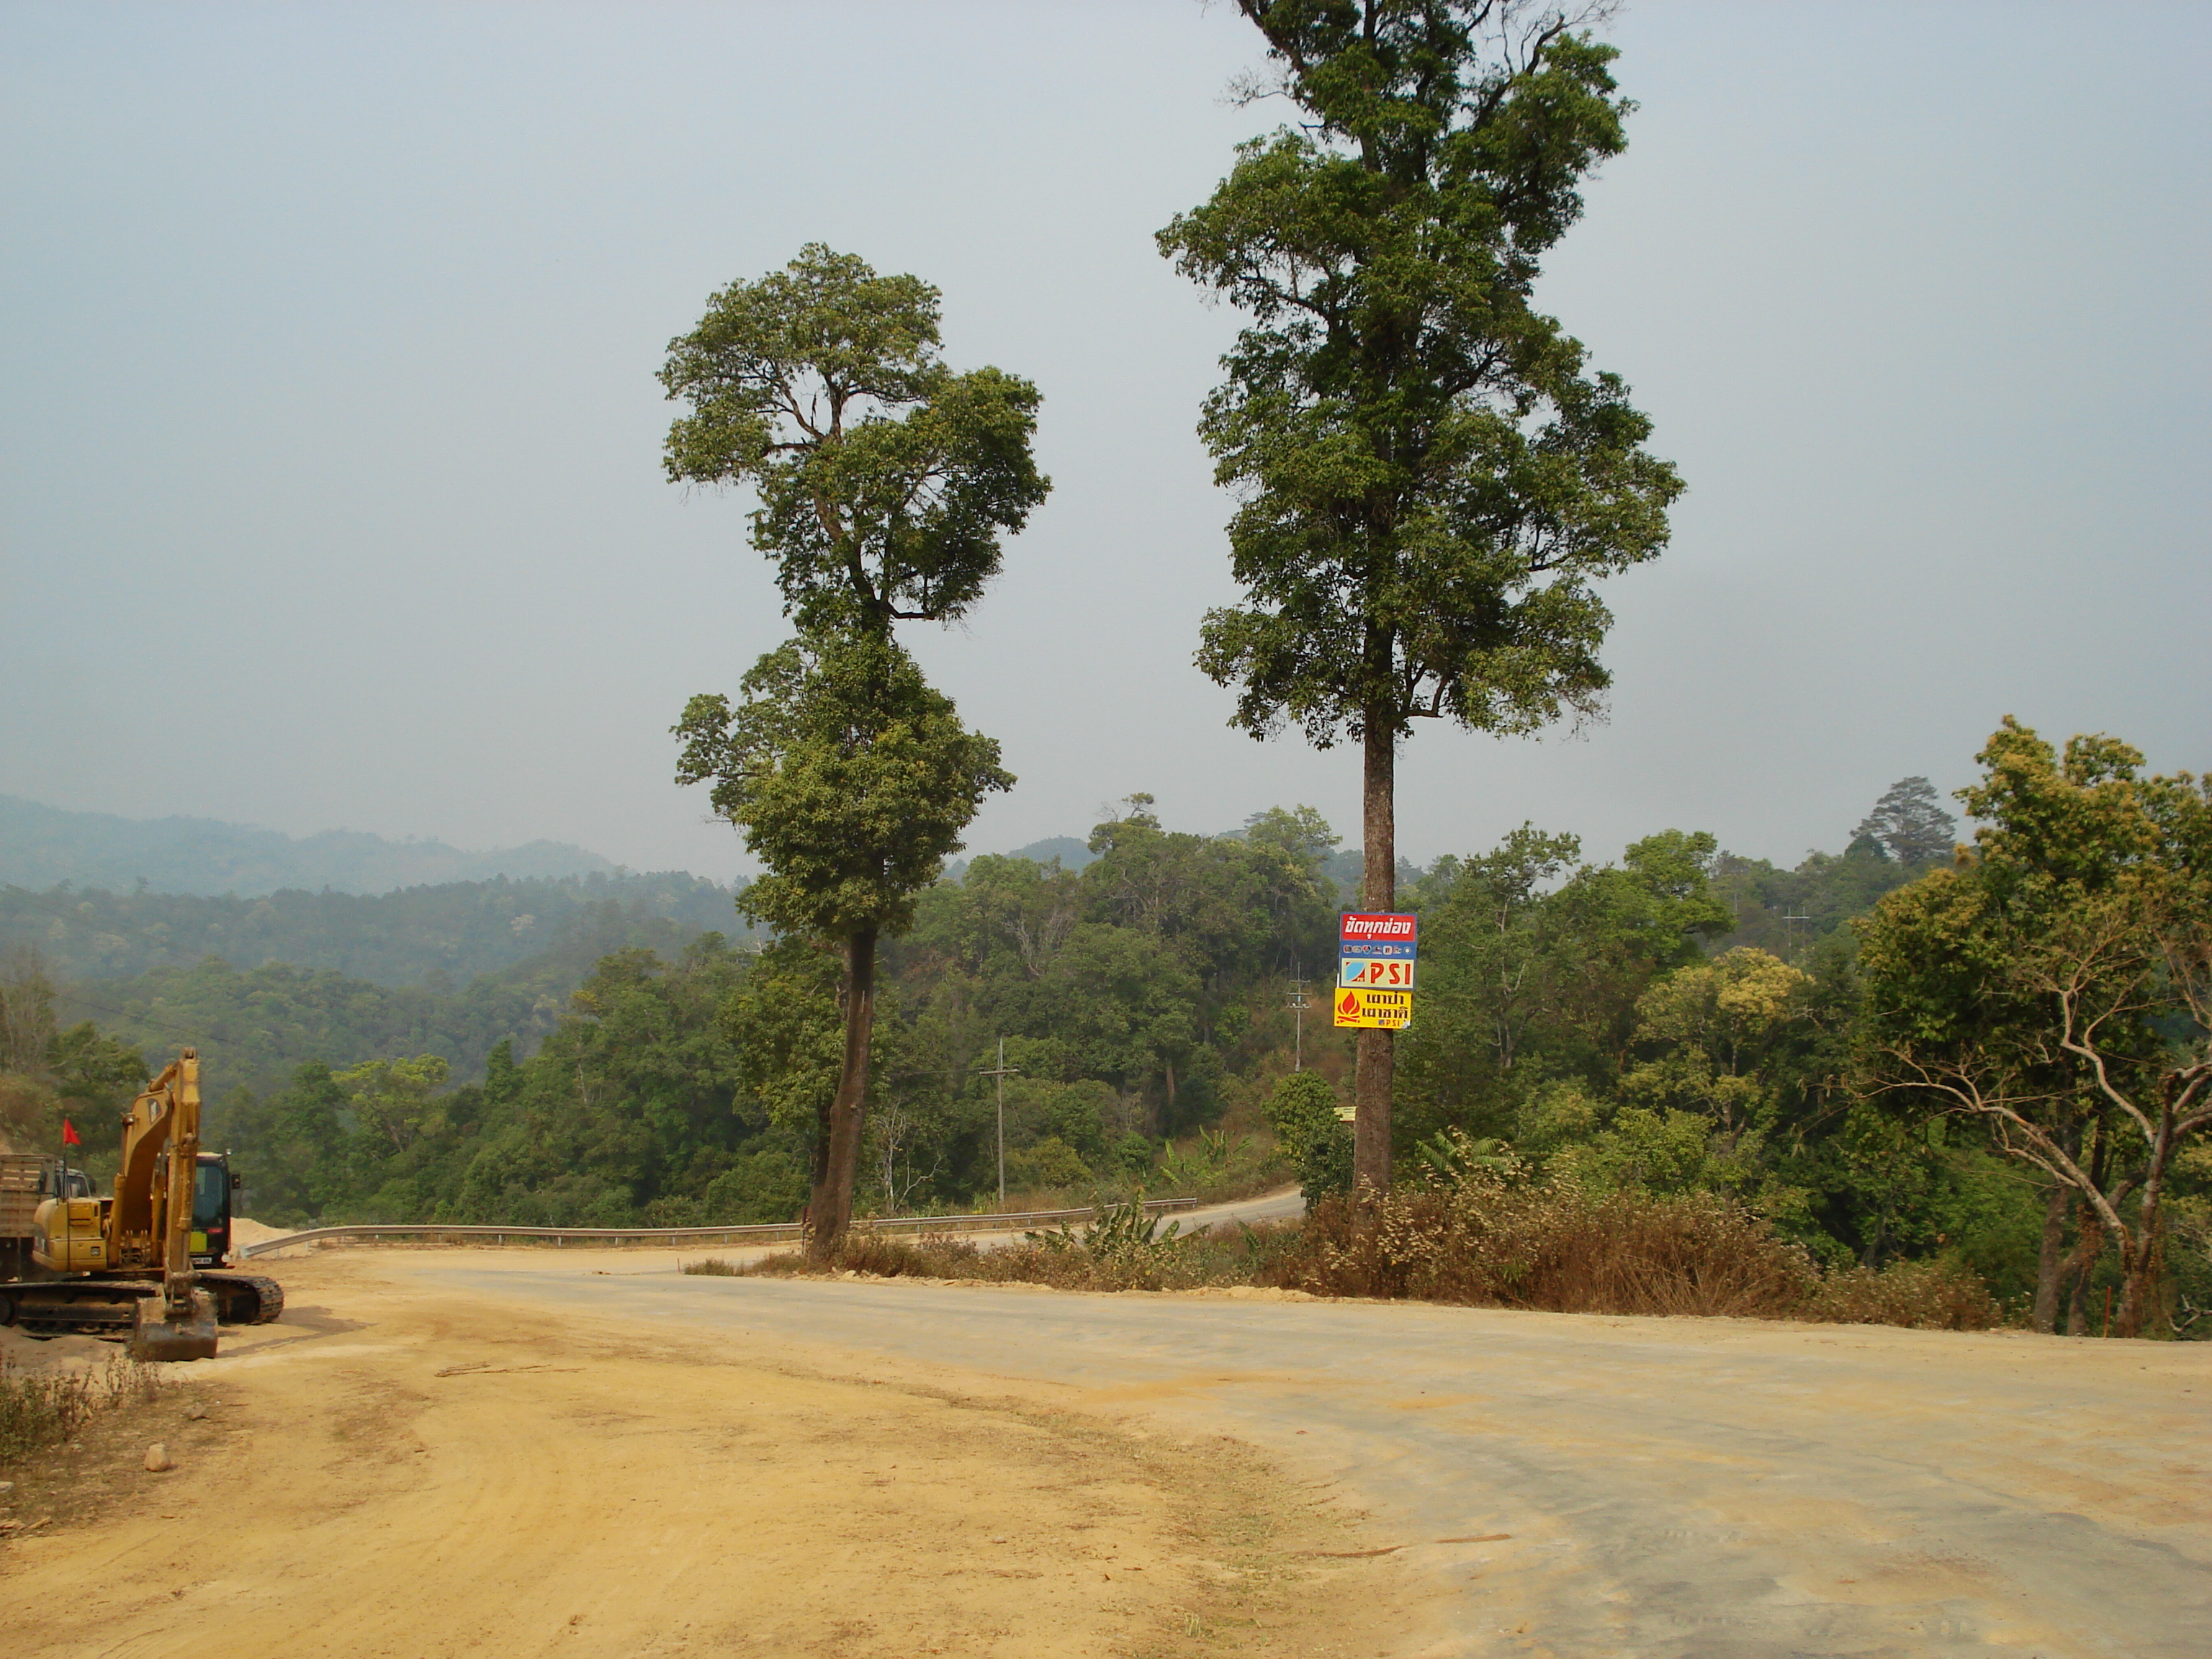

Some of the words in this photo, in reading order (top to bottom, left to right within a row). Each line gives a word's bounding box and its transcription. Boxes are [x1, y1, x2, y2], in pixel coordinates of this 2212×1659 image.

[1345, 916, 1411, 939] ชัดทุกช่อง
[1370, 962, 1411, 984] PSI
[1367, 991, 1404, 1004] เผาป่า
